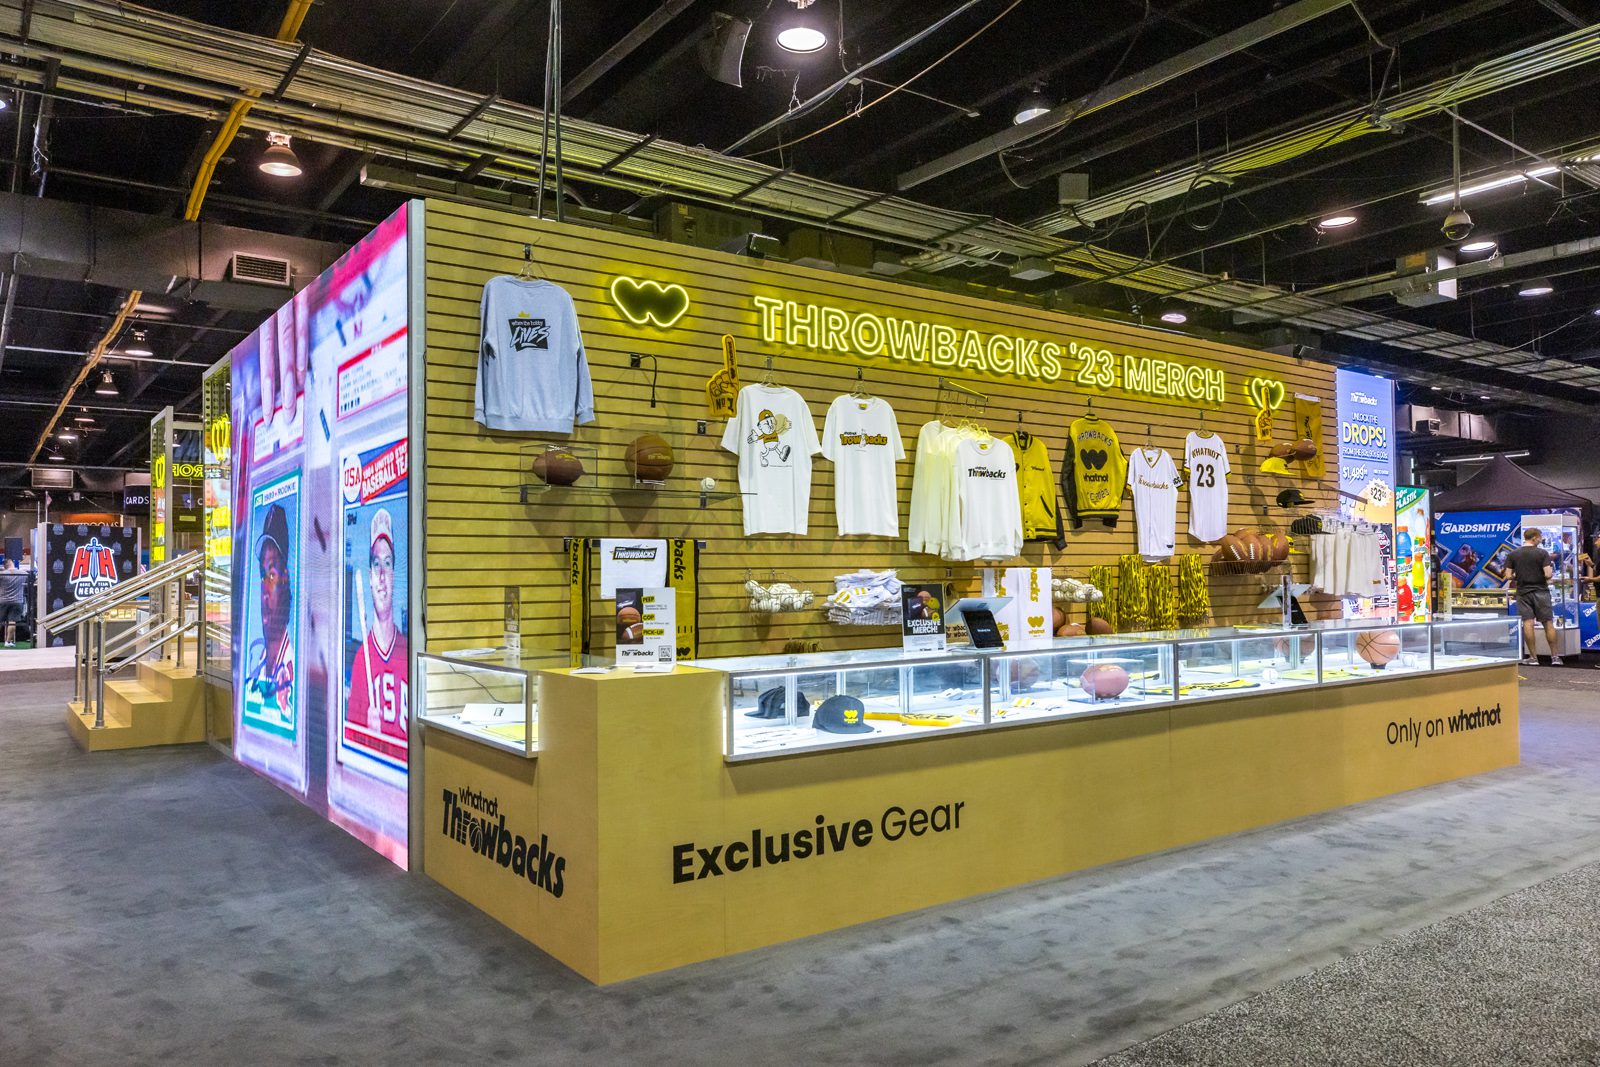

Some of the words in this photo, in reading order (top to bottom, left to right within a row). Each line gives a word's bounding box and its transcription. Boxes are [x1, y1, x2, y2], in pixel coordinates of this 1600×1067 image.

[510, 325, 551, 348] LIVES
[753, 295, 1062, 380] THROWBACKS
[1069, 341, 1115, 388] '23
[1123, 355, 1226, 403] MERCH
[1342, 421, 1387, 448] DROPS!
[344, 467, 360, 487] USA
[1196, 463, 1216, 488] 23
[125, 496, 150, 505] CARDS
[1440, 522, 1511, 534] CARDSMITHS
[907, 618, 942, 628] EXCLUSIVE
[912, 625, 938, 634] MERCH!
[1386, 717, 1422, 748] Only
[1425, 718, 1444, 738] on
[1448, 702, 1501, 734] whatnot
[458, 785, 499, 819] whatnot
[442, 788, 566, 899] Throwbacks
[673, 814, 874, 884] Exclusive
[880, 800, 965, 842] Gear
